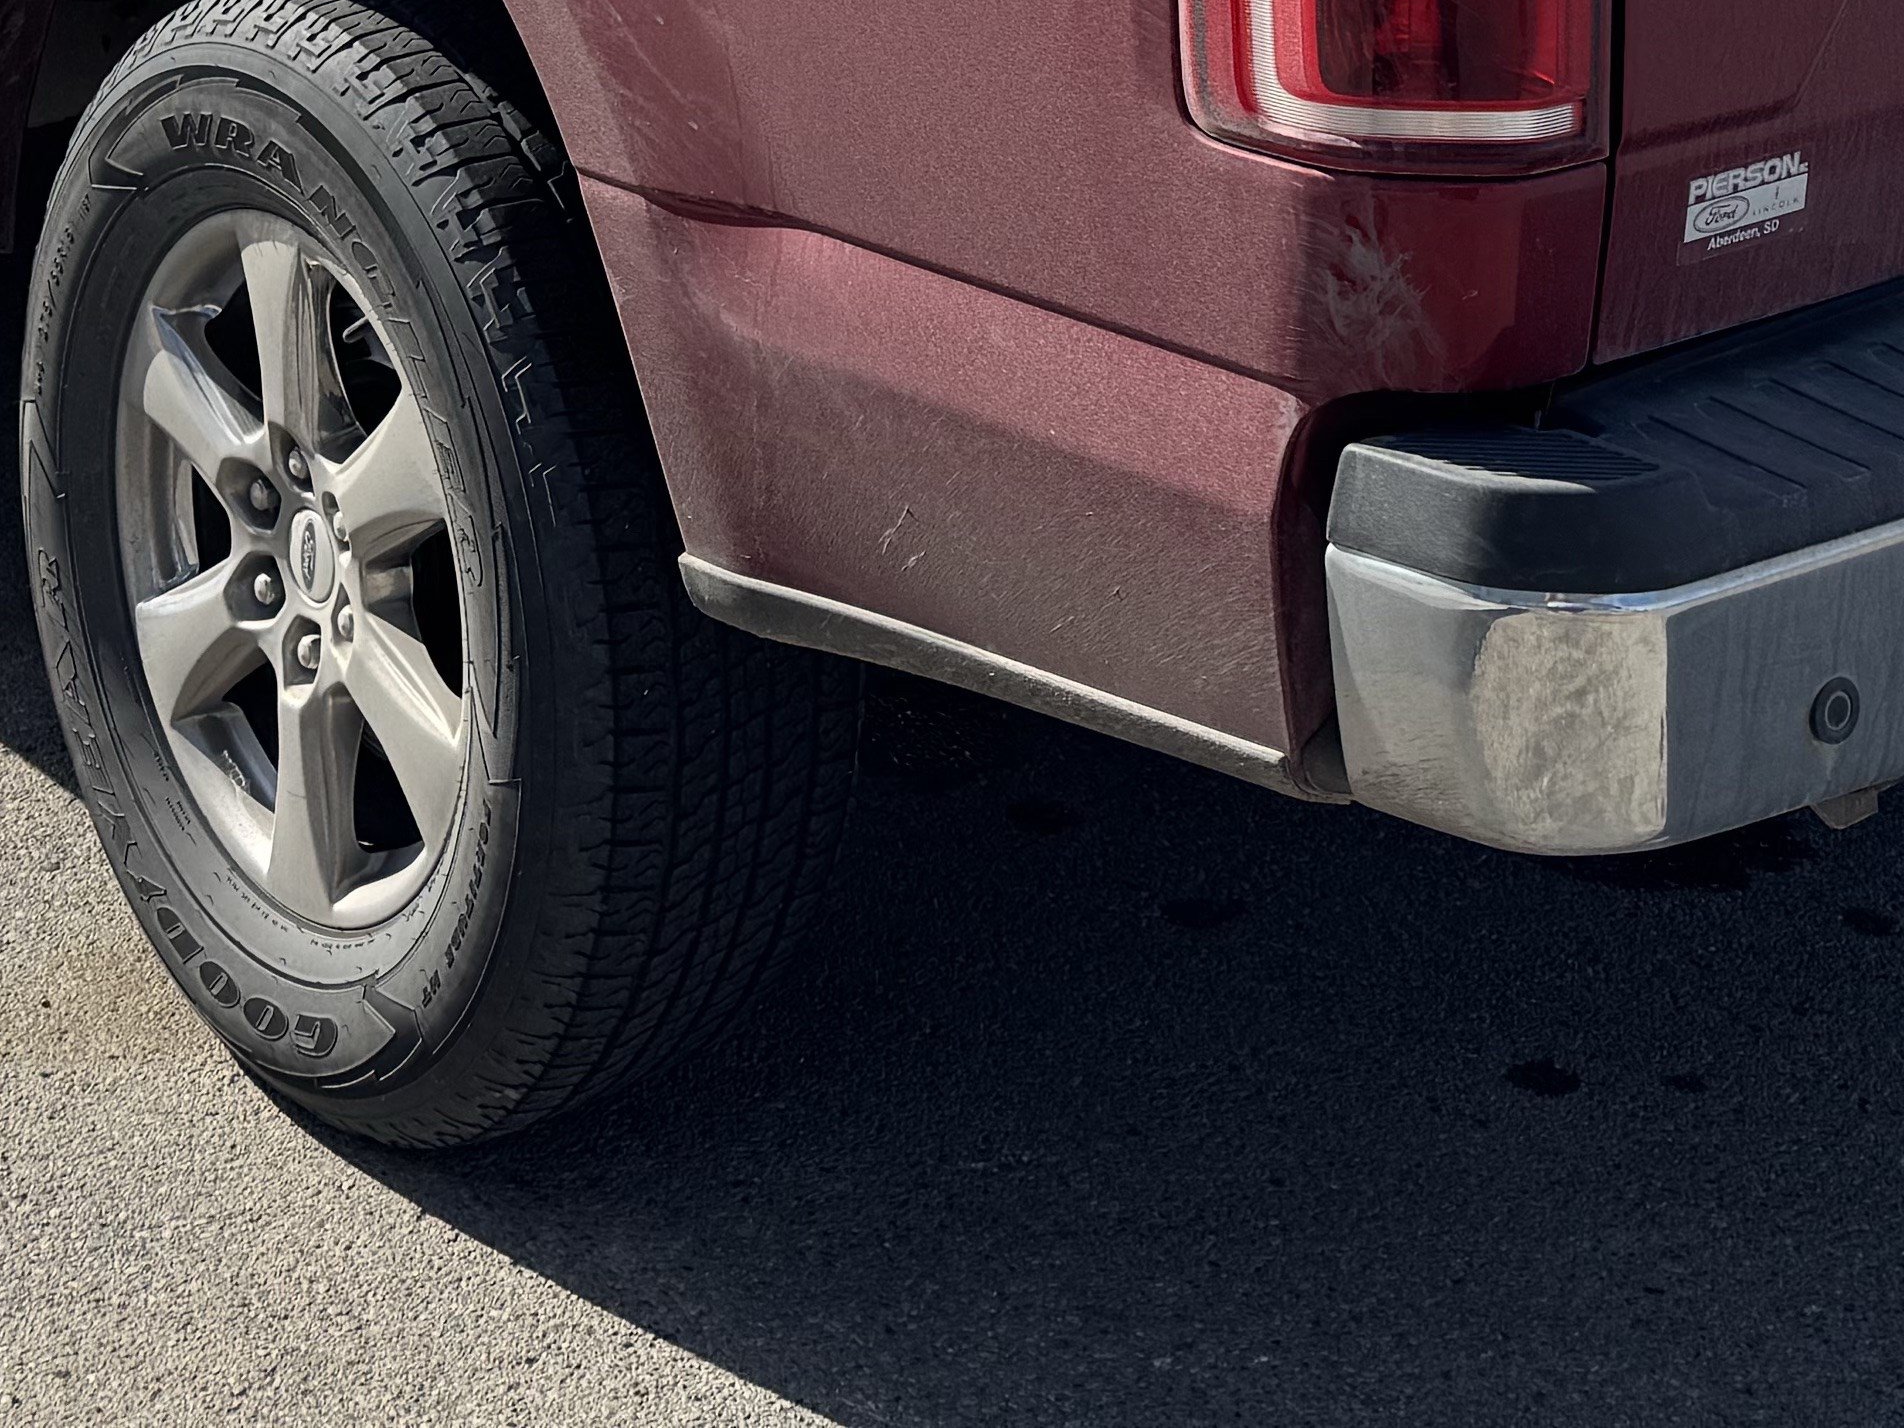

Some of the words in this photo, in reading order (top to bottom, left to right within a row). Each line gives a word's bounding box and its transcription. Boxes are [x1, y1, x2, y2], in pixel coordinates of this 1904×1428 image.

[1689, 151, 1801, 204] PIERSON
[1703, 201, 1739, 226] Ford
[1763, 219, 1780, 235] SD
